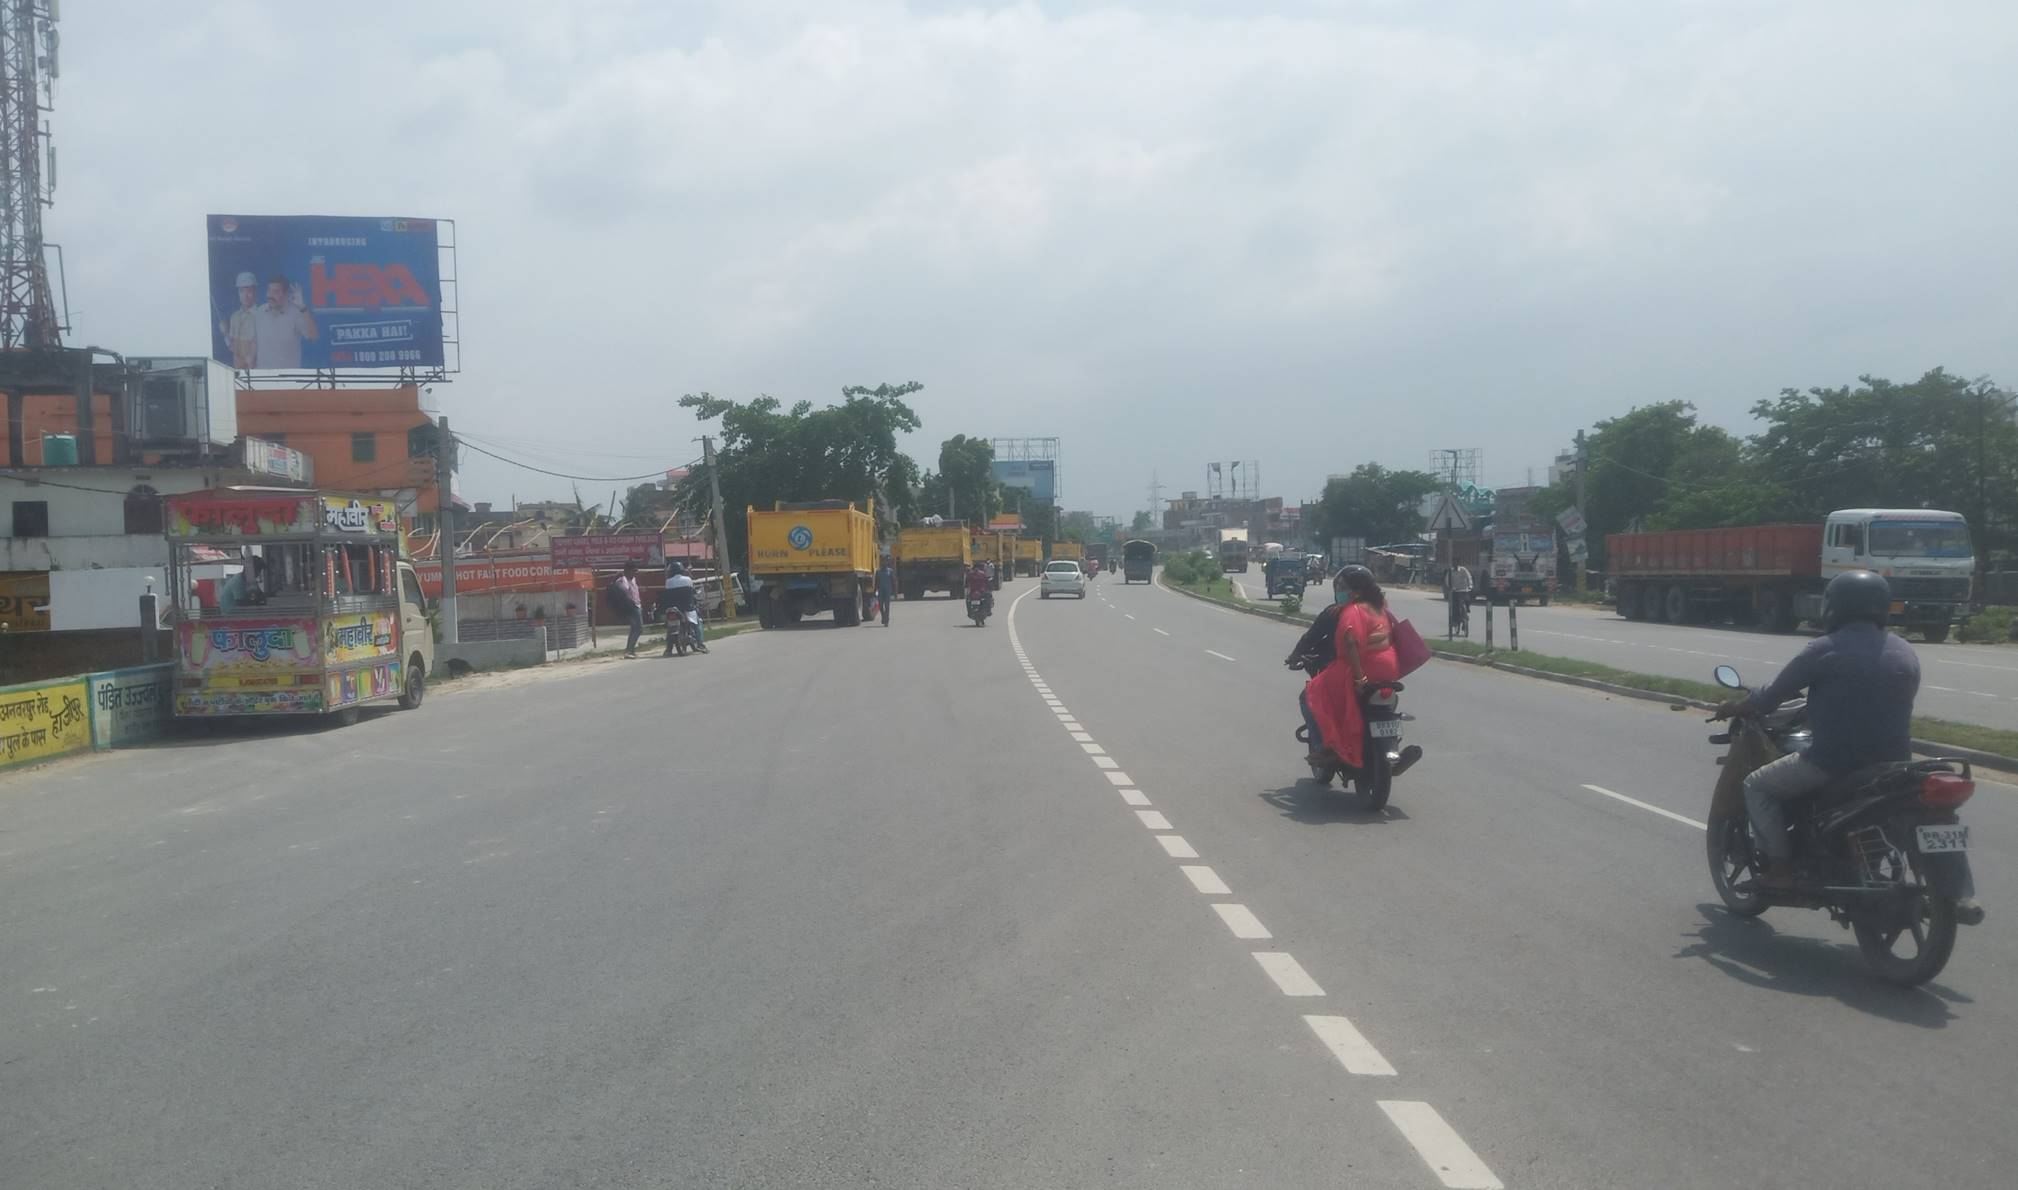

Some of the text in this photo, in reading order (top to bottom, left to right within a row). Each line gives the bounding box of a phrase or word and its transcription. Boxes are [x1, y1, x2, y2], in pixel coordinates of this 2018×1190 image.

[336, 327, 378, 340] PAKKA
[326, 499, 369, 530] महावीर
[809, 547, 847, 557] PLEASE
[456, 570, 476, 581] HOT
[502, 567, 528, 578] FOOD
[338, 615, 374, 650] महावीर
[49, 695, 85, 740] हाजीपुर
[6, 734, 21, 760] पुल
